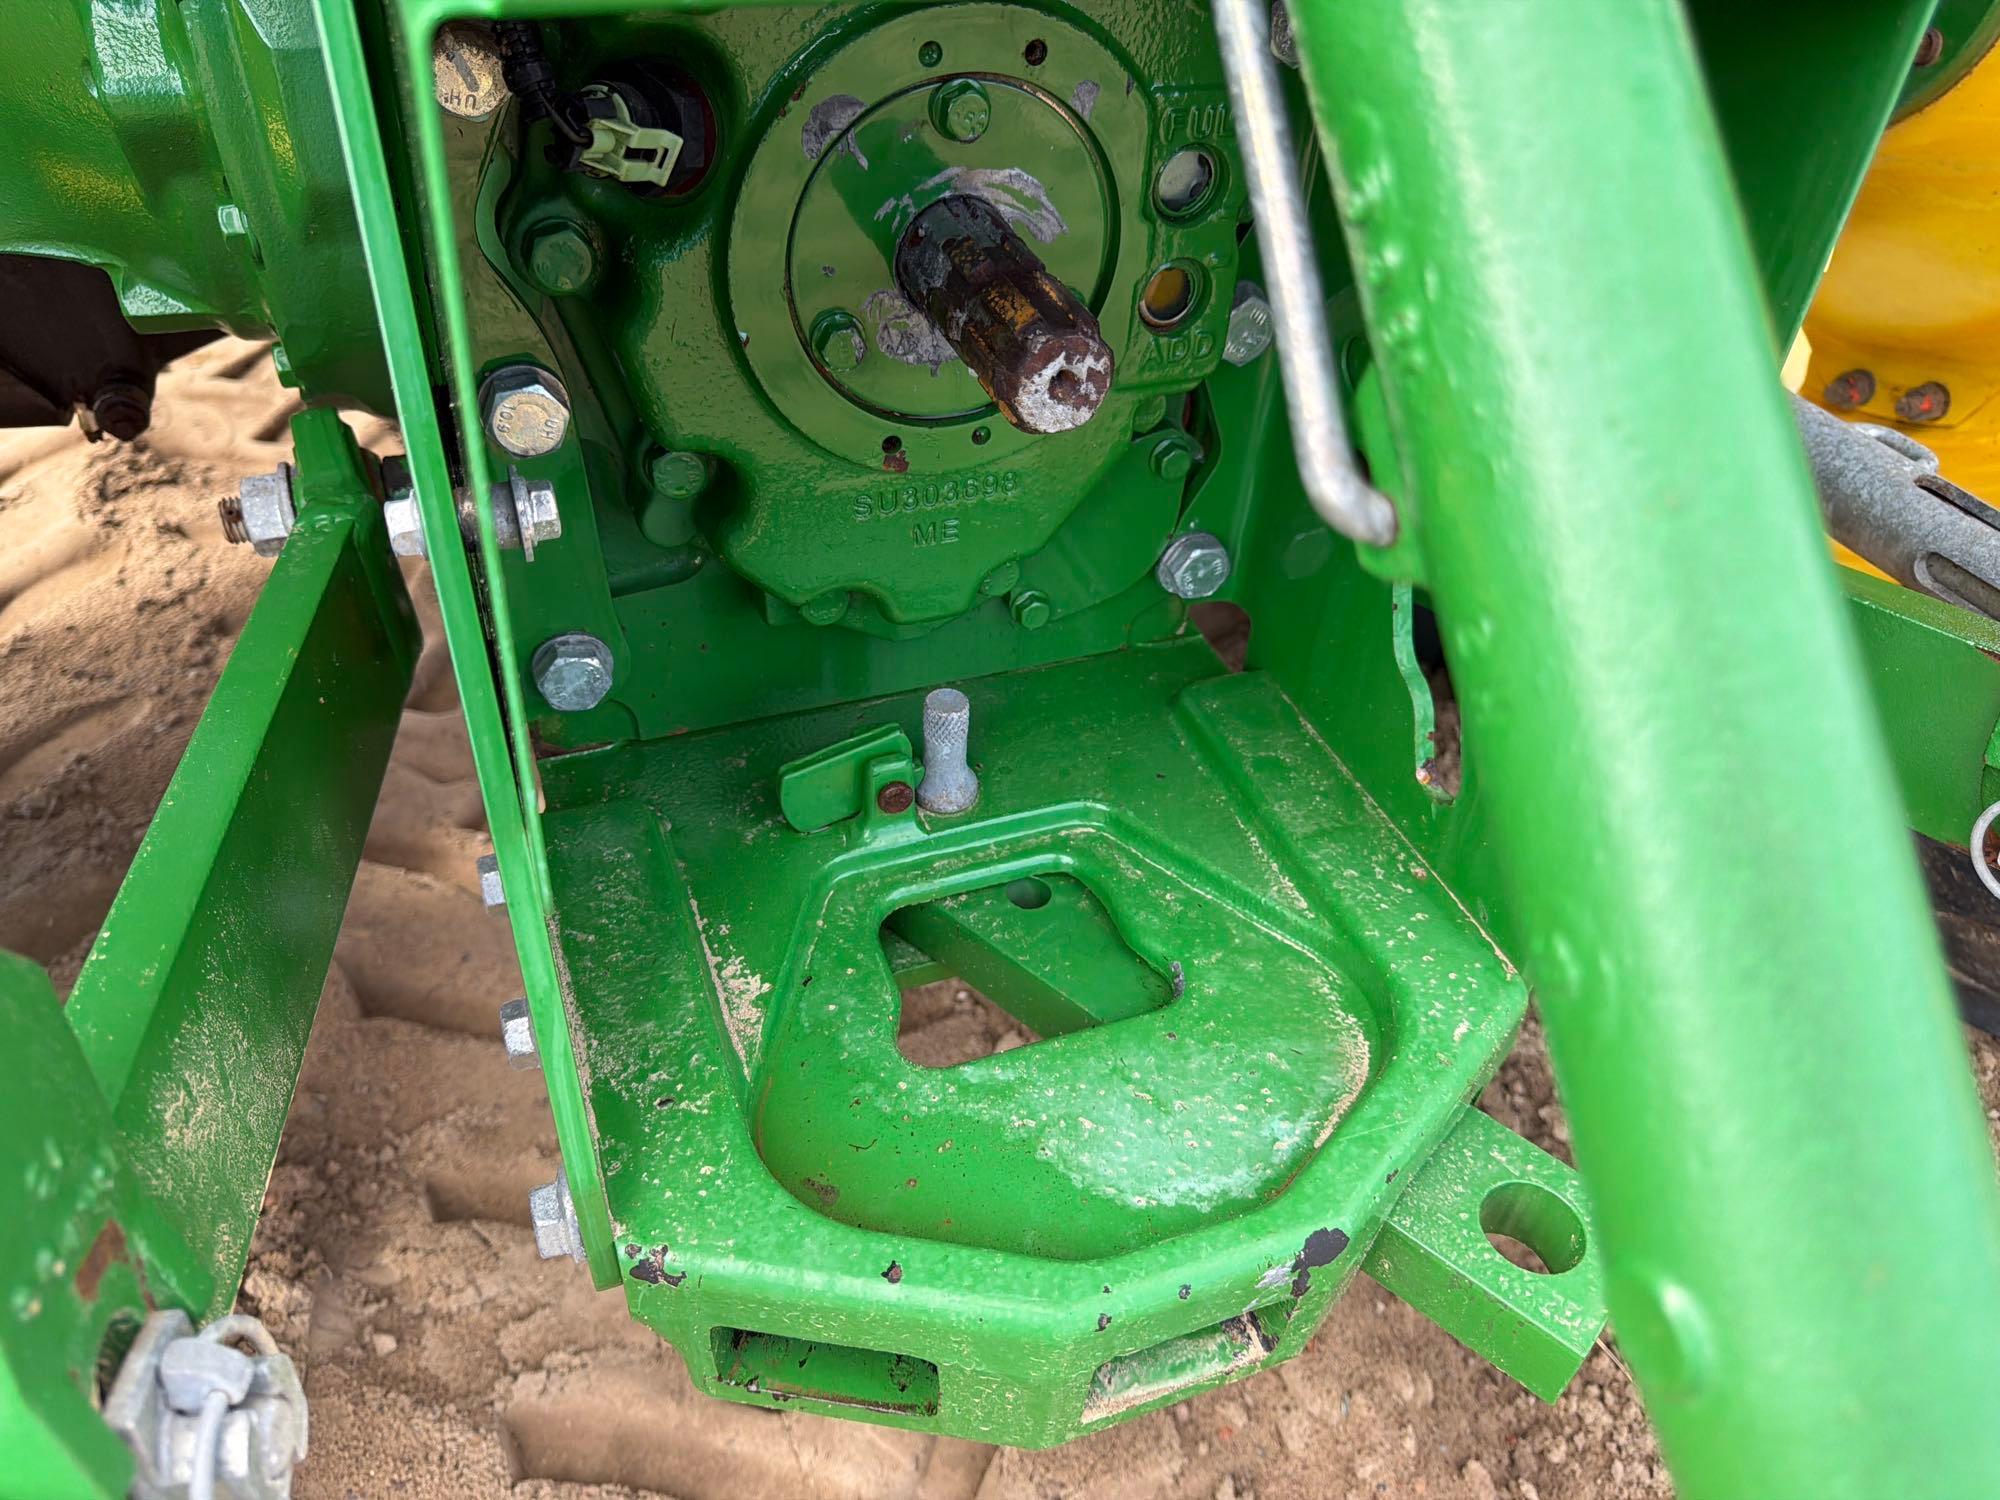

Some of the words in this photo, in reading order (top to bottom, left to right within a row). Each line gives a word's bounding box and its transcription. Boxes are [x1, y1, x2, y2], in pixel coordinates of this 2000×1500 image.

[1159, 104, 1235, 144] FUL
[1141, 327, 1214, 368] ADD
[913, 518, 960, 548] ME
